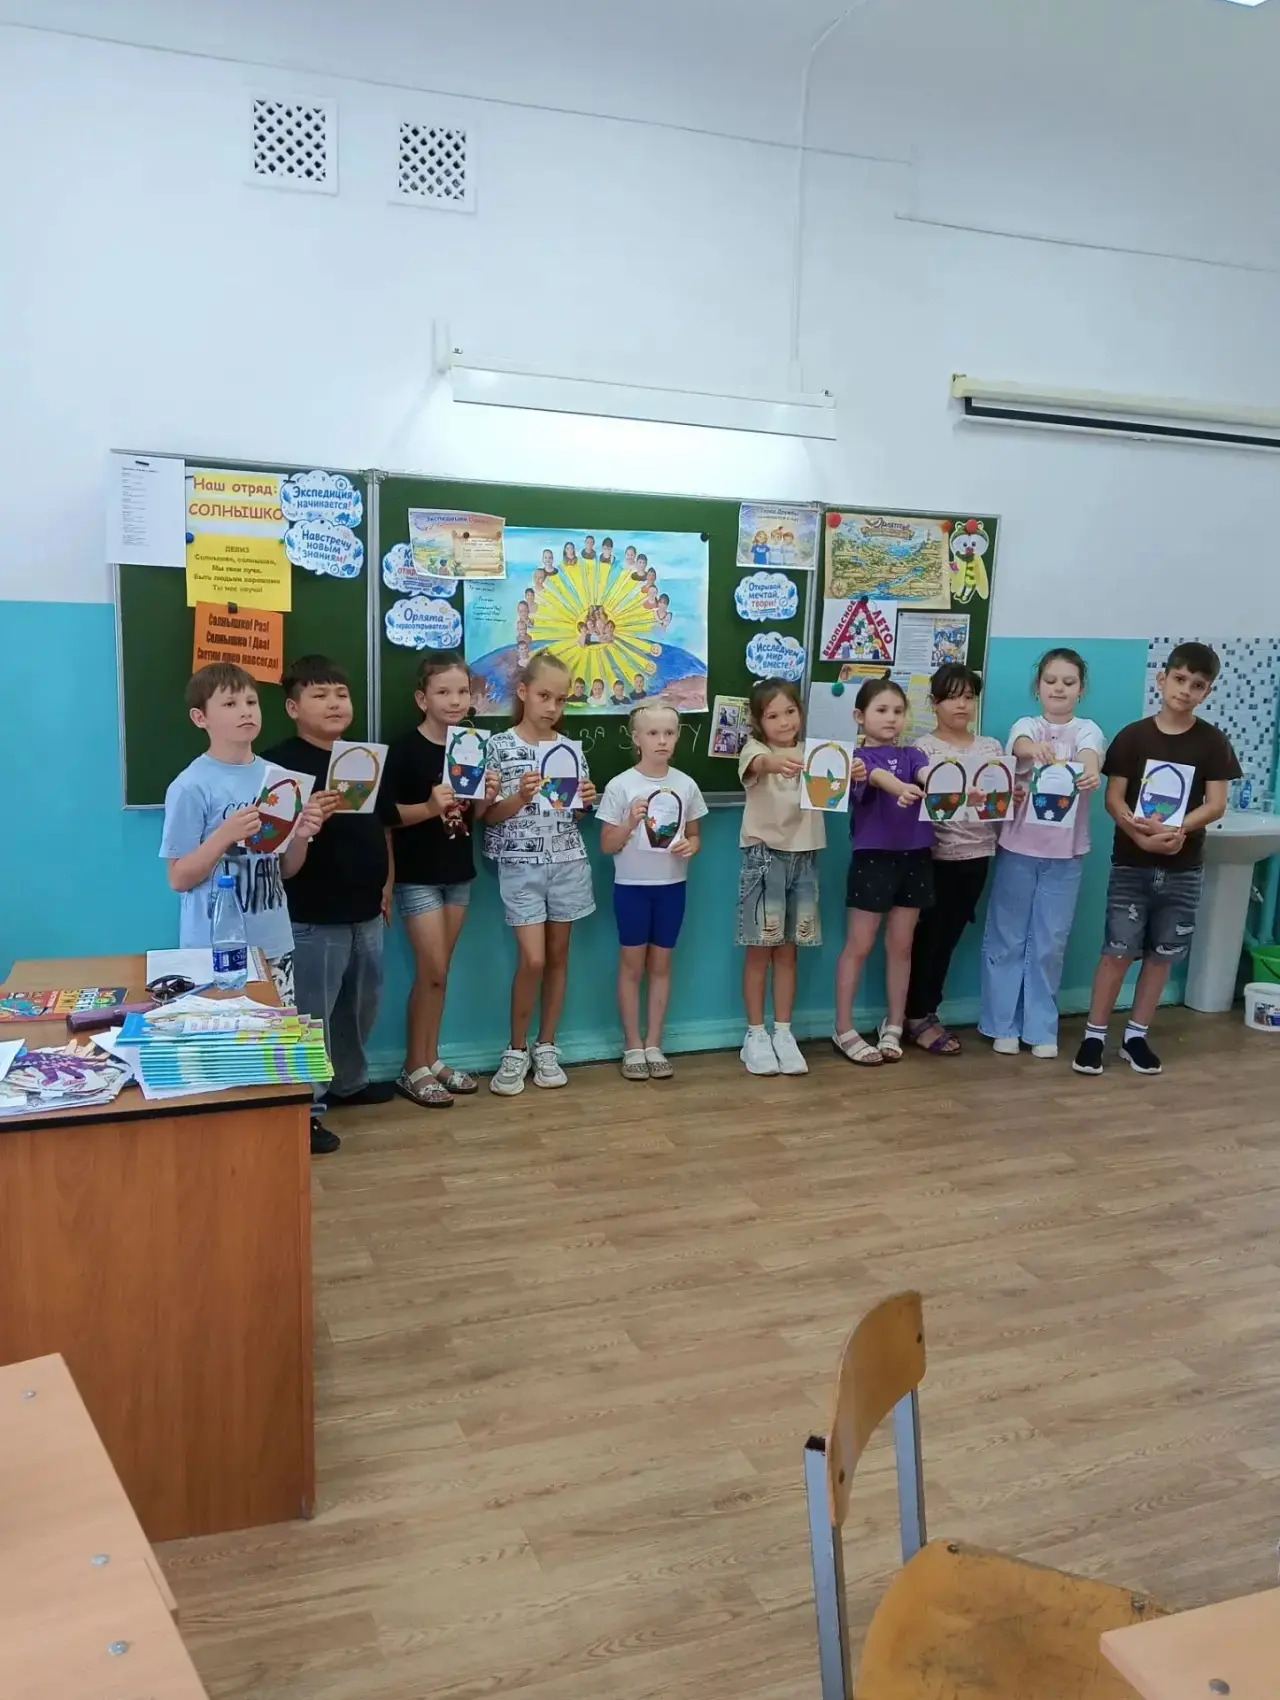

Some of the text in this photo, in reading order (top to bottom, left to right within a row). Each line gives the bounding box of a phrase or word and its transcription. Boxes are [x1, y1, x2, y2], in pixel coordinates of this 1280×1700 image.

[194, 477, 278, 497] Наш отряд:
[293, 486, 353, 500] Экспедиция
[189, 503, 283, 520] СОЛНЫШКО
[297, 500, 352, 510] начинается!
[302, 529, 353, 551] Навстречу
[306, 542, 341, 555] новым
[302, 550, 348, 564] знаниям!
[208, 613, 270, 633] Солнышко! Раз!
[404, 607, 444, 624] Орлята
[822, 600, 857, 657] БЕЗОПАСНОЕ
[872, 609, 894, 645] ЛЕТО
[252, 636, 270, 651] Два!
